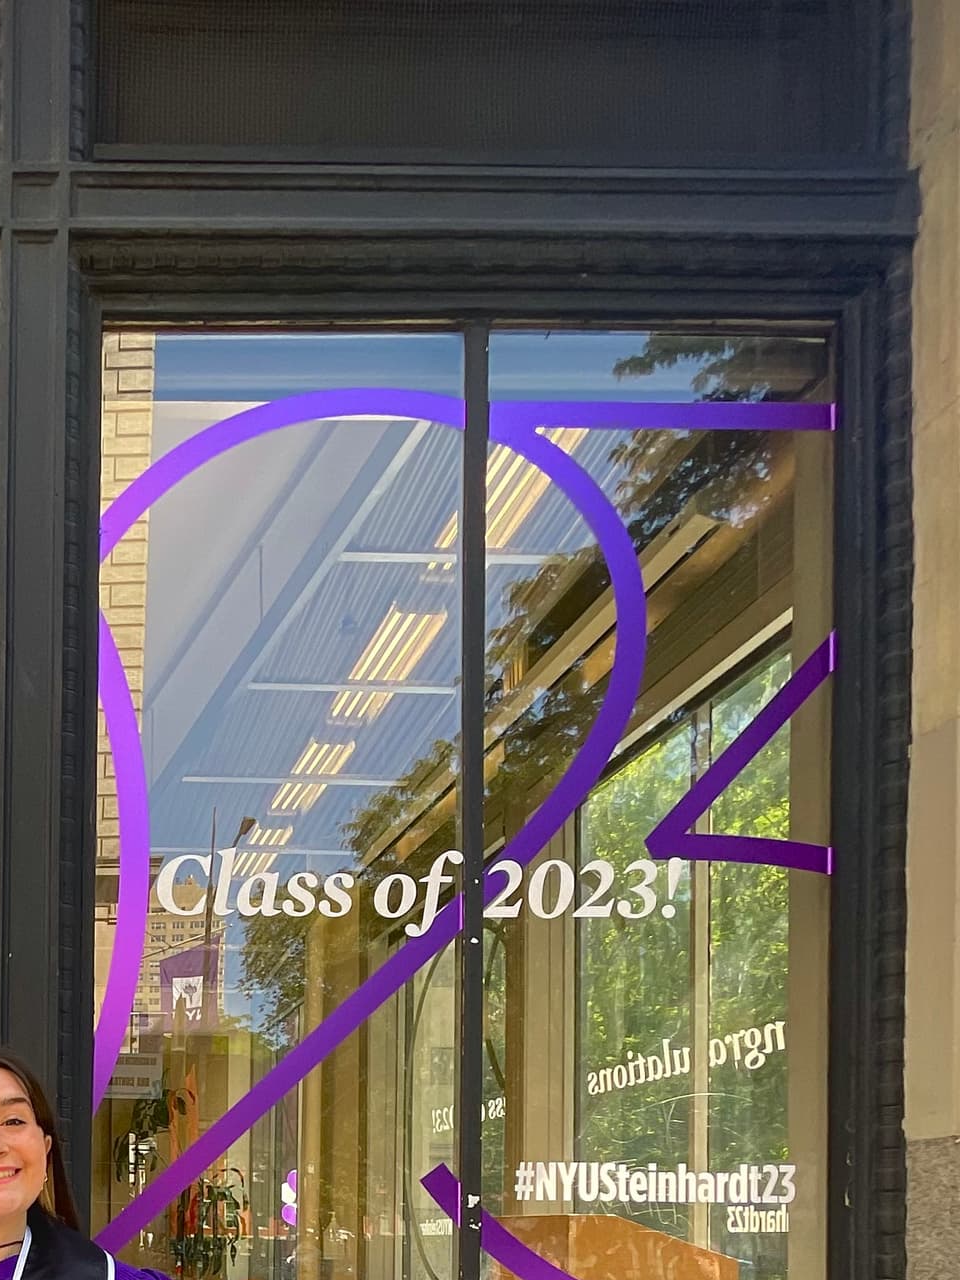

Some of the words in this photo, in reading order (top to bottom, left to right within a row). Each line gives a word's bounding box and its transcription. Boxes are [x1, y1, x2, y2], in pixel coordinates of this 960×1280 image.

[155, 847, 354, 918] Class
[373, 850, 464, 938] of
[483, 857, 689, 920] 2023!
[514, 1161, 796, 1204] #NYUSteinhardt23
